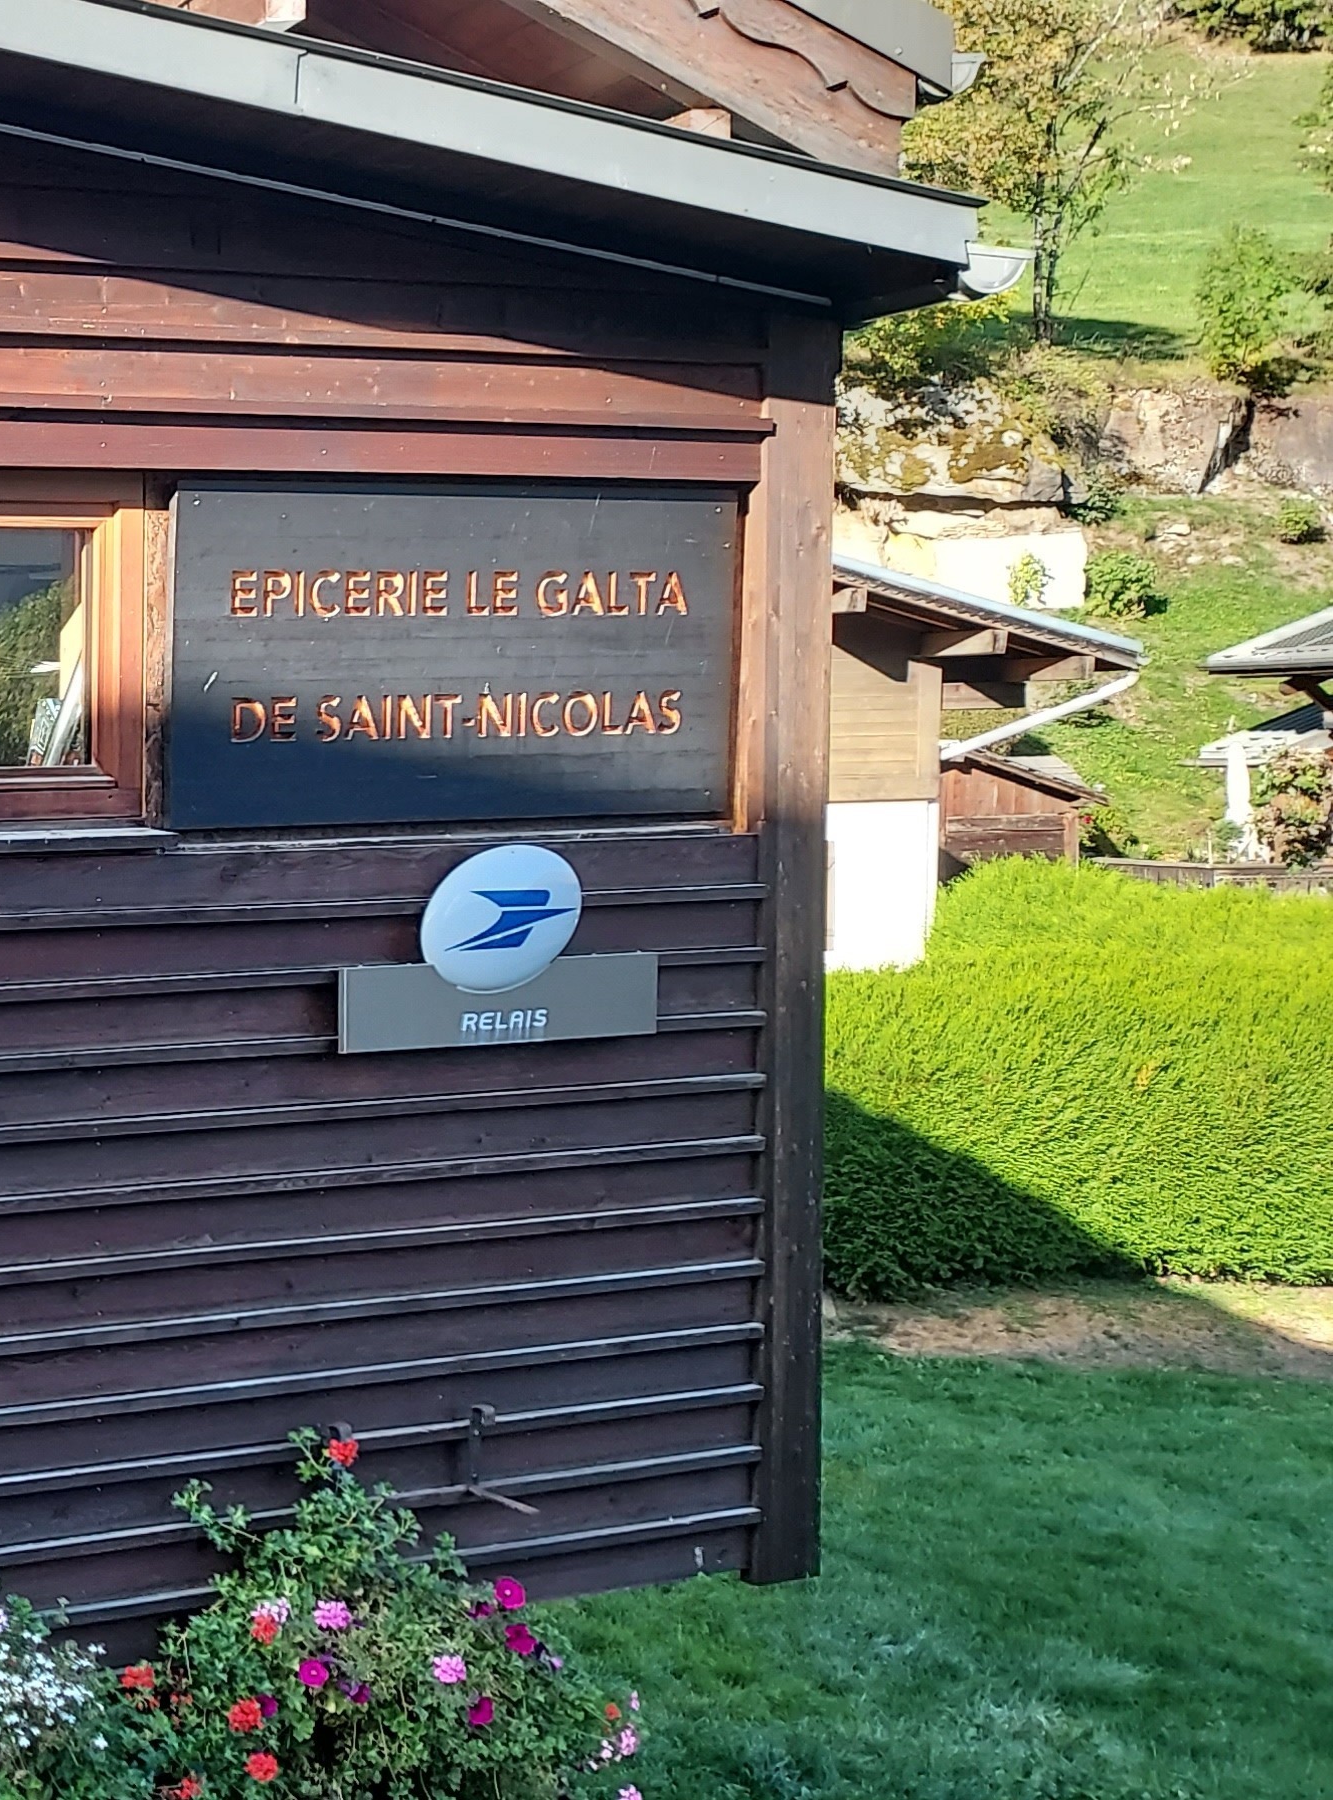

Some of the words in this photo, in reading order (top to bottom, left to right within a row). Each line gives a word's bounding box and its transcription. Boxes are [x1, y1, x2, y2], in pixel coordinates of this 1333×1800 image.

[231, 569, 449, 619] EPICERIE
[465, 570, 519, 617] LE
[535, 569, 689, 618] GALTA
[230, 697, 298, 744] DE
[316, 689, 683, 742] SAINT-NICOLAS
[460, 1008, 549, 1032] RELAIS
